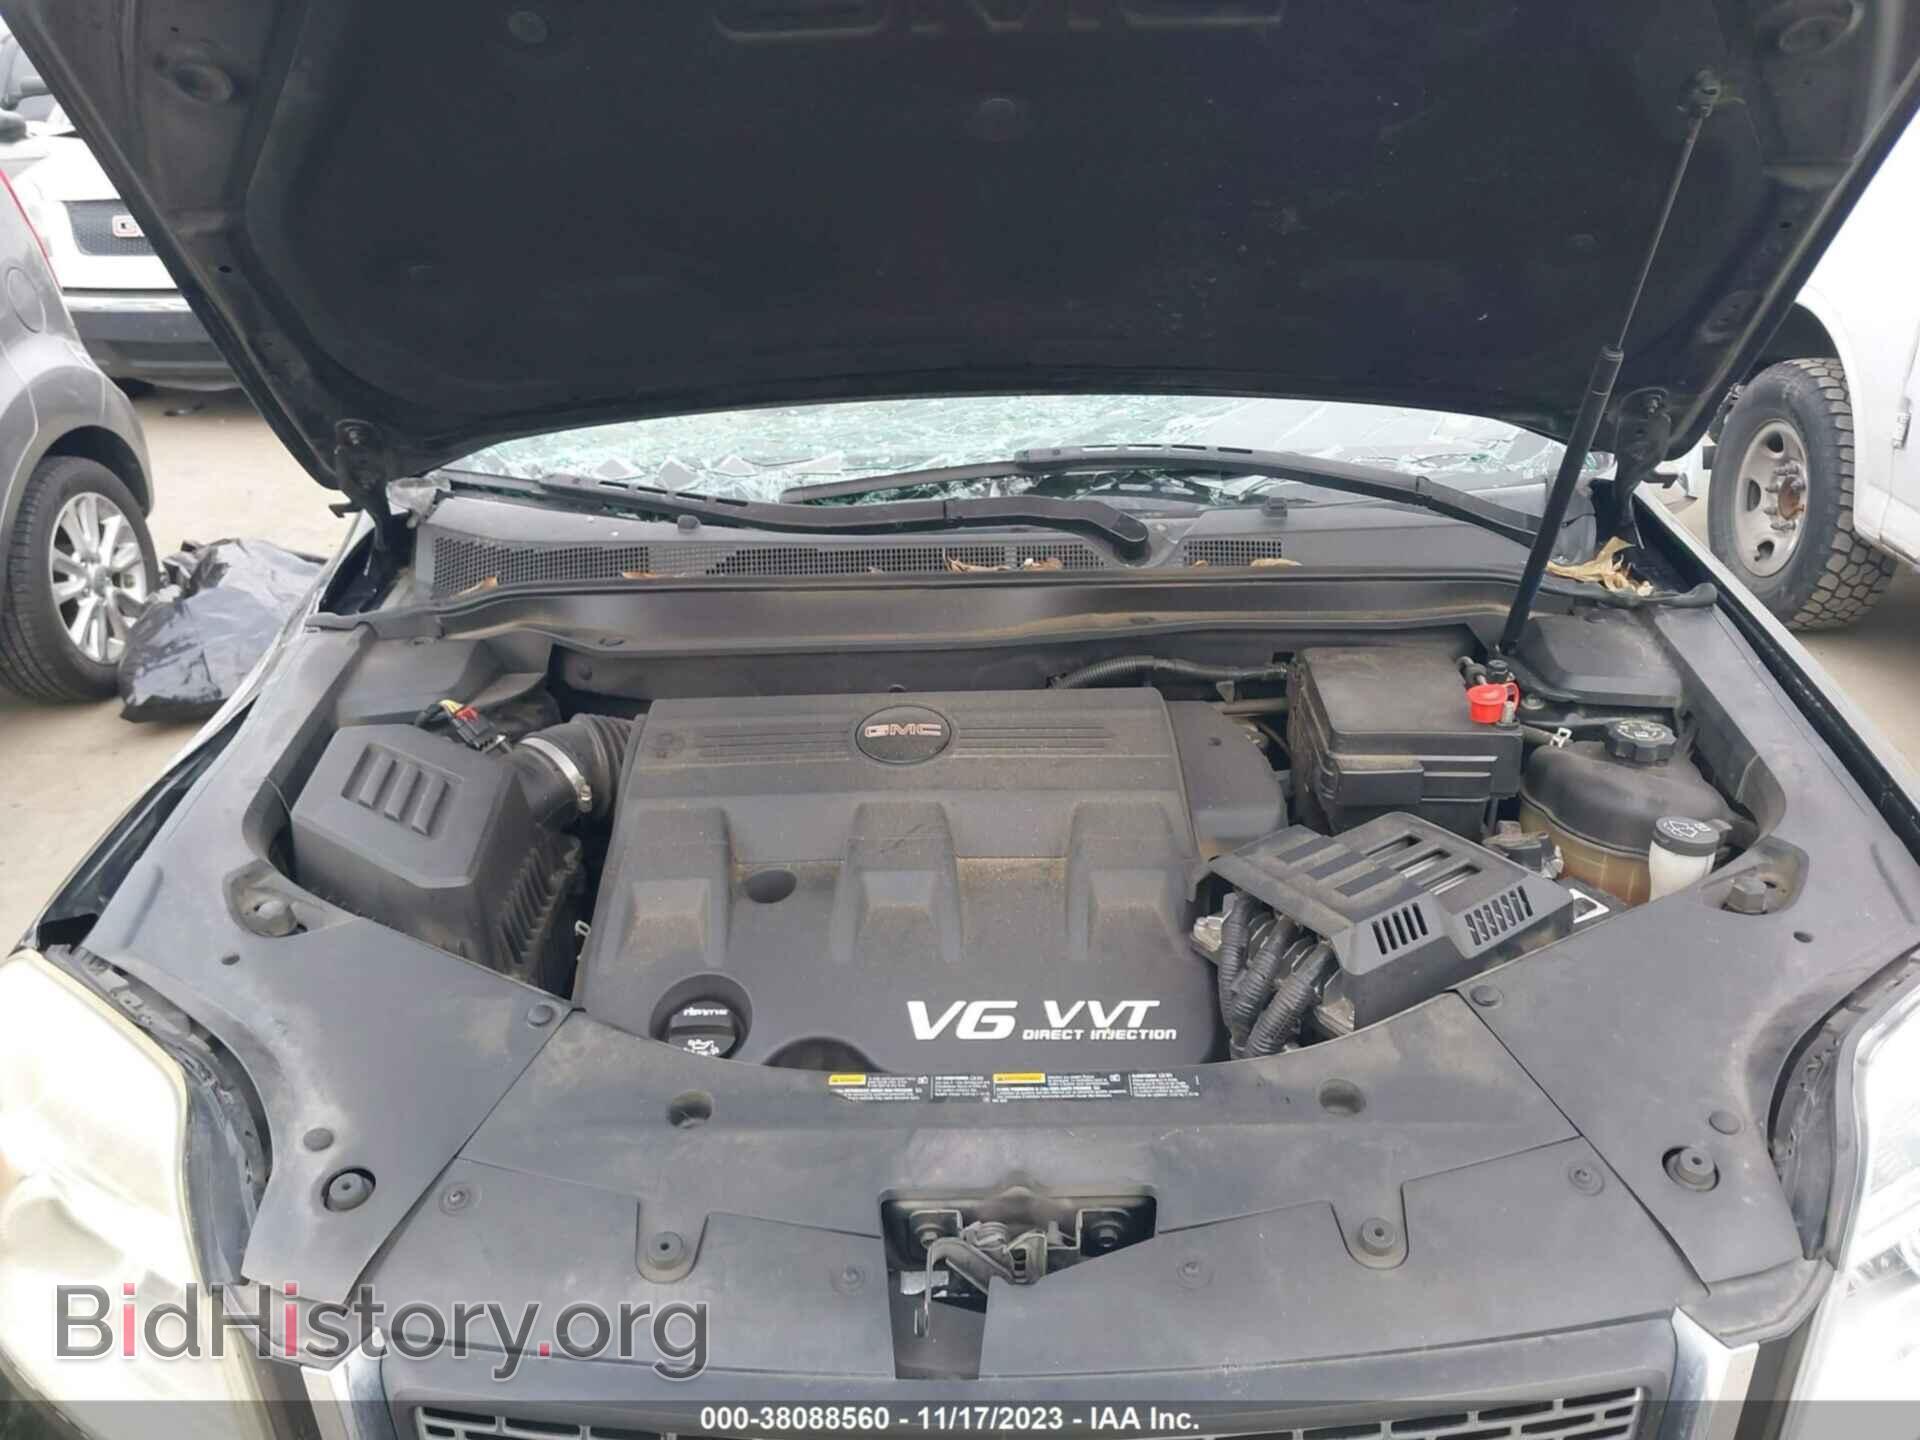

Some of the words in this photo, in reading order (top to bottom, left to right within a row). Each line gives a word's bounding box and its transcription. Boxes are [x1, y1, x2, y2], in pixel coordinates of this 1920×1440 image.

[864, 723, 942, 738] GMC
[907, 1000, 1018, 1040] V6
[1043, 1000, 1161, 1028] VVT
[1022, 1029, 1084, 1041] DIRECT
[1090, 1029, 1177, 1041] INJECTION
